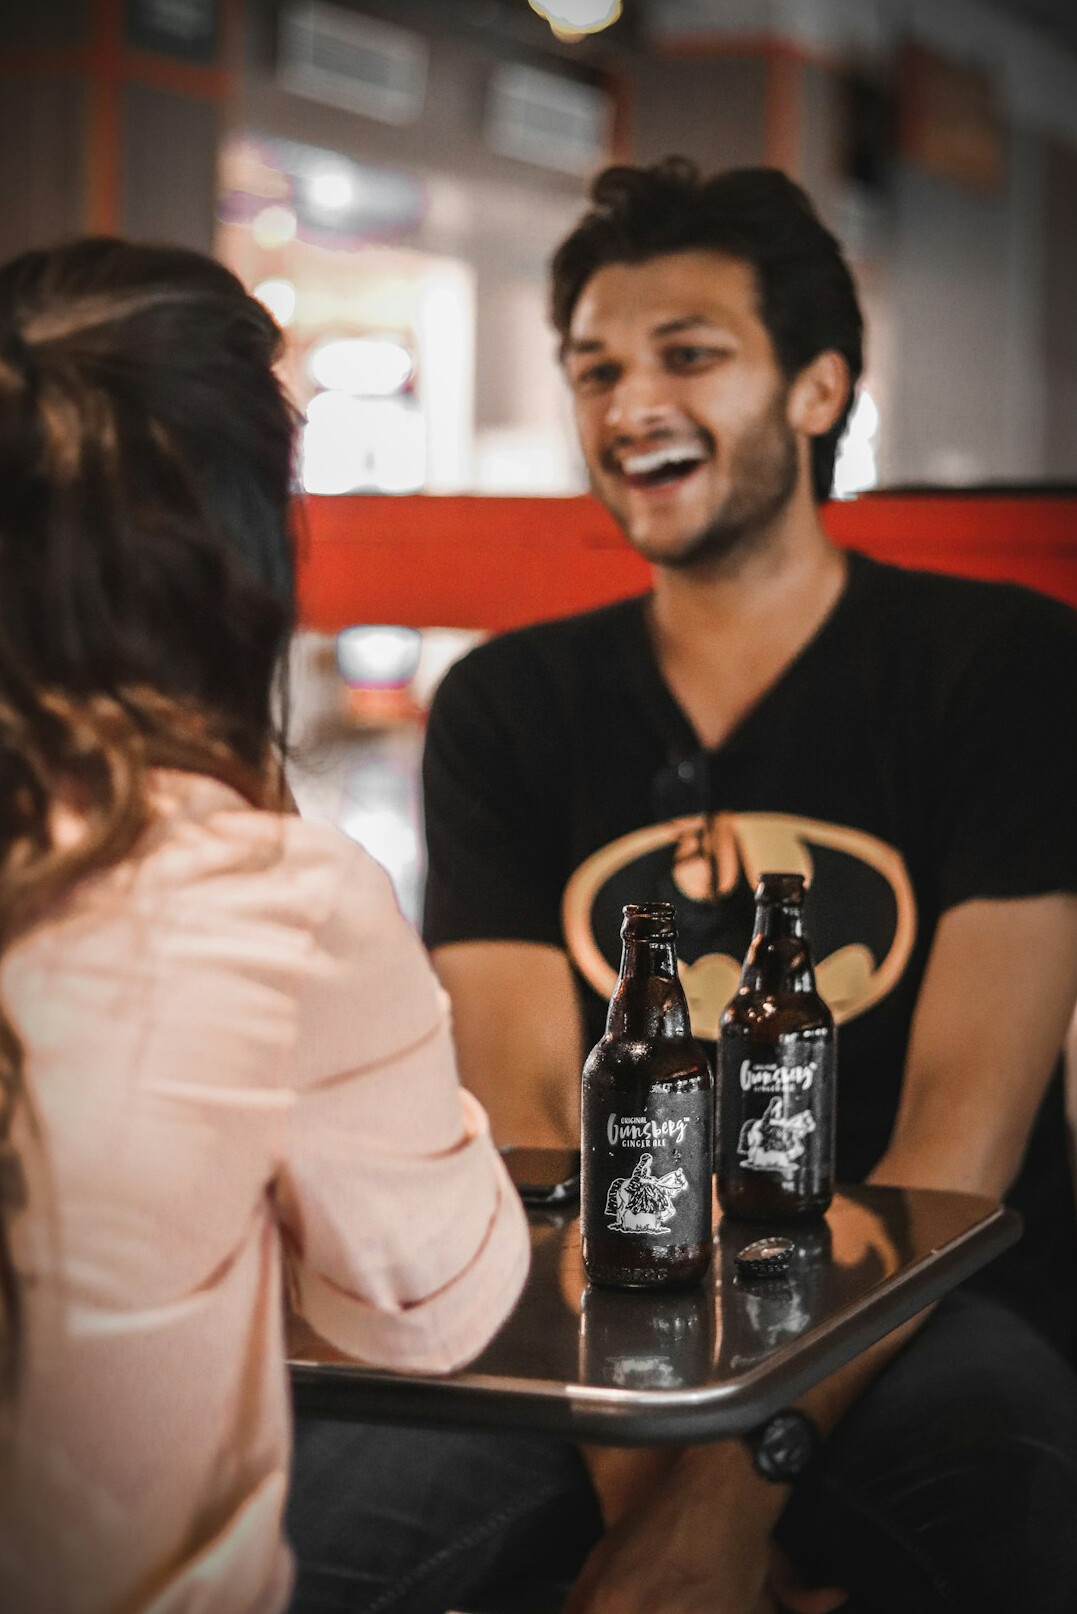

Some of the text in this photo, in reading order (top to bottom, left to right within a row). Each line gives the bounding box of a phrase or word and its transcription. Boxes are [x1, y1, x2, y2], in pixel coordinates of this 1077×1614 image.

[607, 1113, 688, 1145] Gunsberg
[621, 1138, 666, 1148] GINGER ALE
